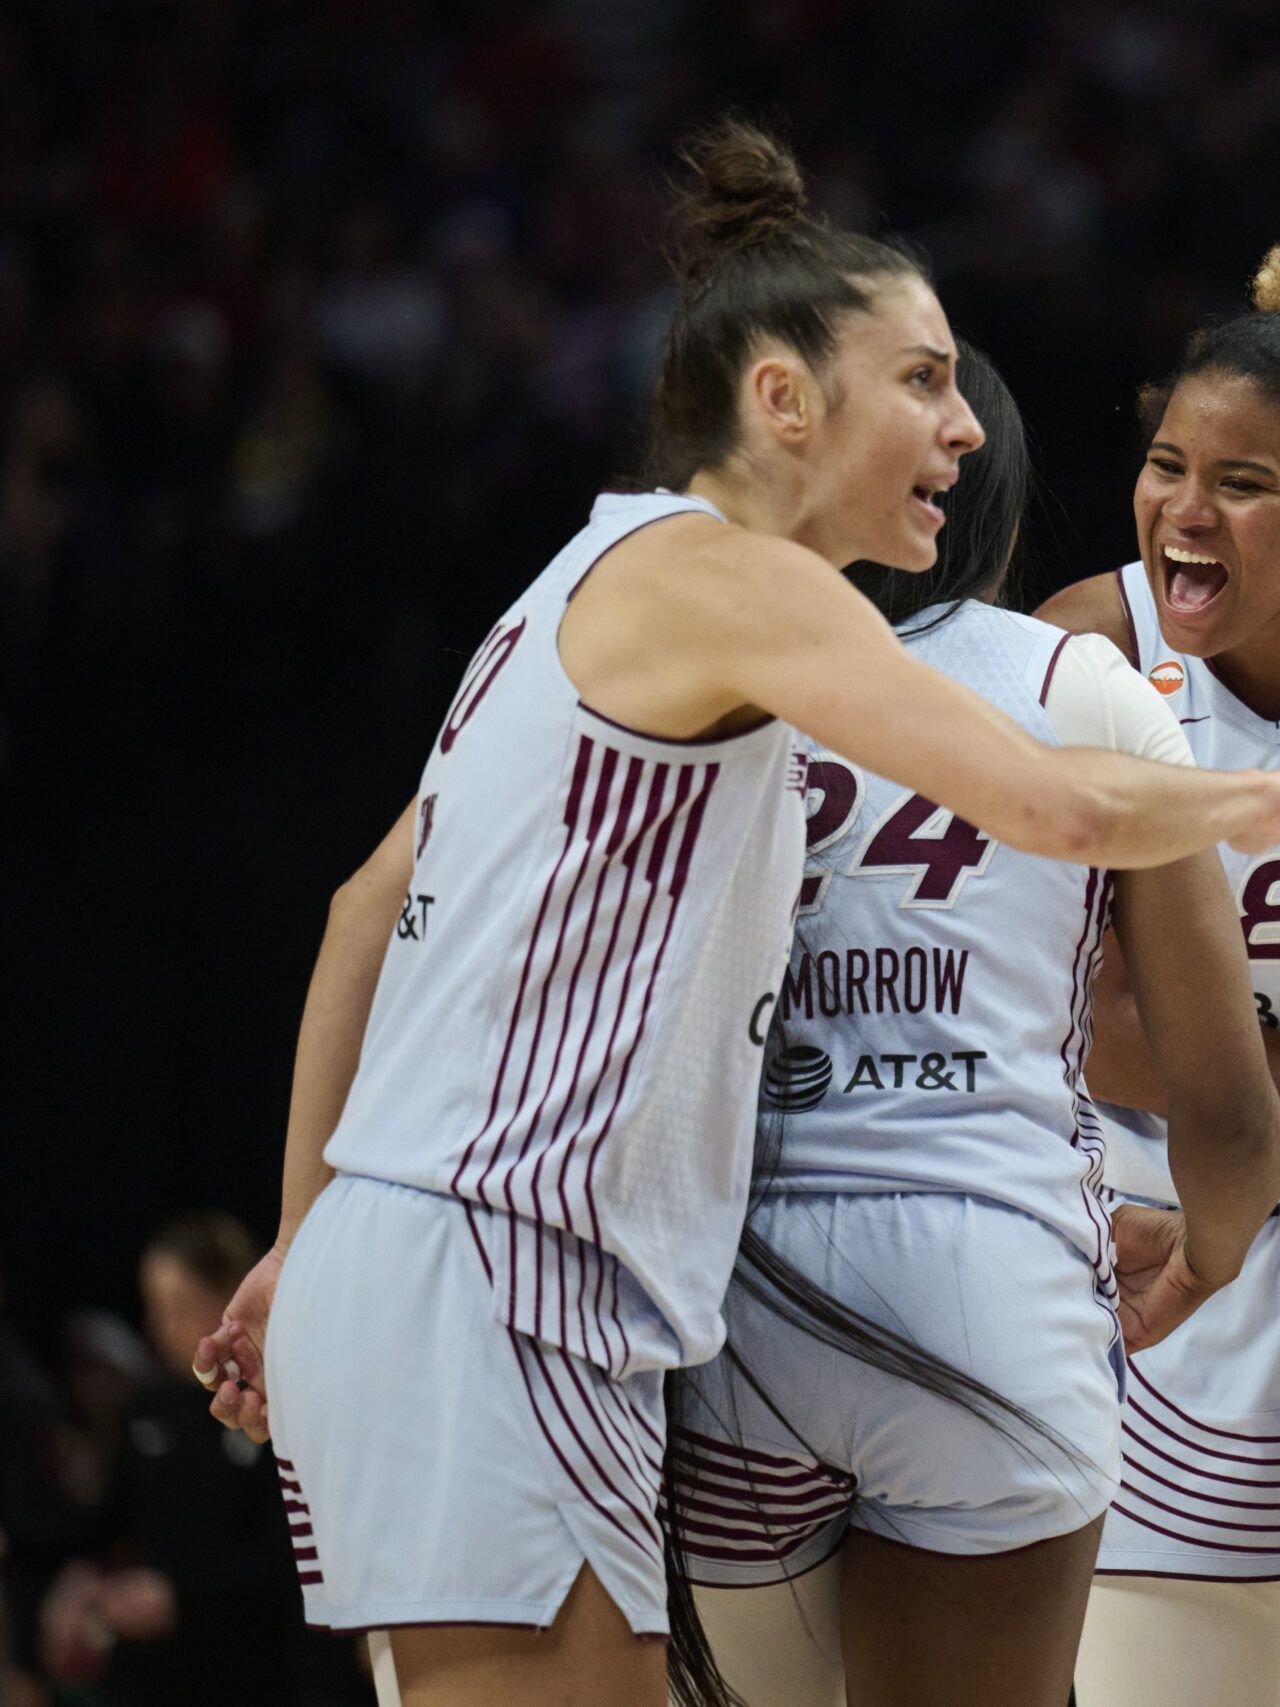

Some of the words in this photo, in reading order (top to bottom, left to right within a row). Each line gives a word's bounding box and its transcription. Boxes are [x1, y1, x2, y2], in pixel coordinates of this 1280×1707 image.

[440, 615, 527, 755] 0
[794, 755, 1001, 911] 24
[781, 946, 969, 1021] MORROW
[842, 1050, 988, 1094] AT&T
